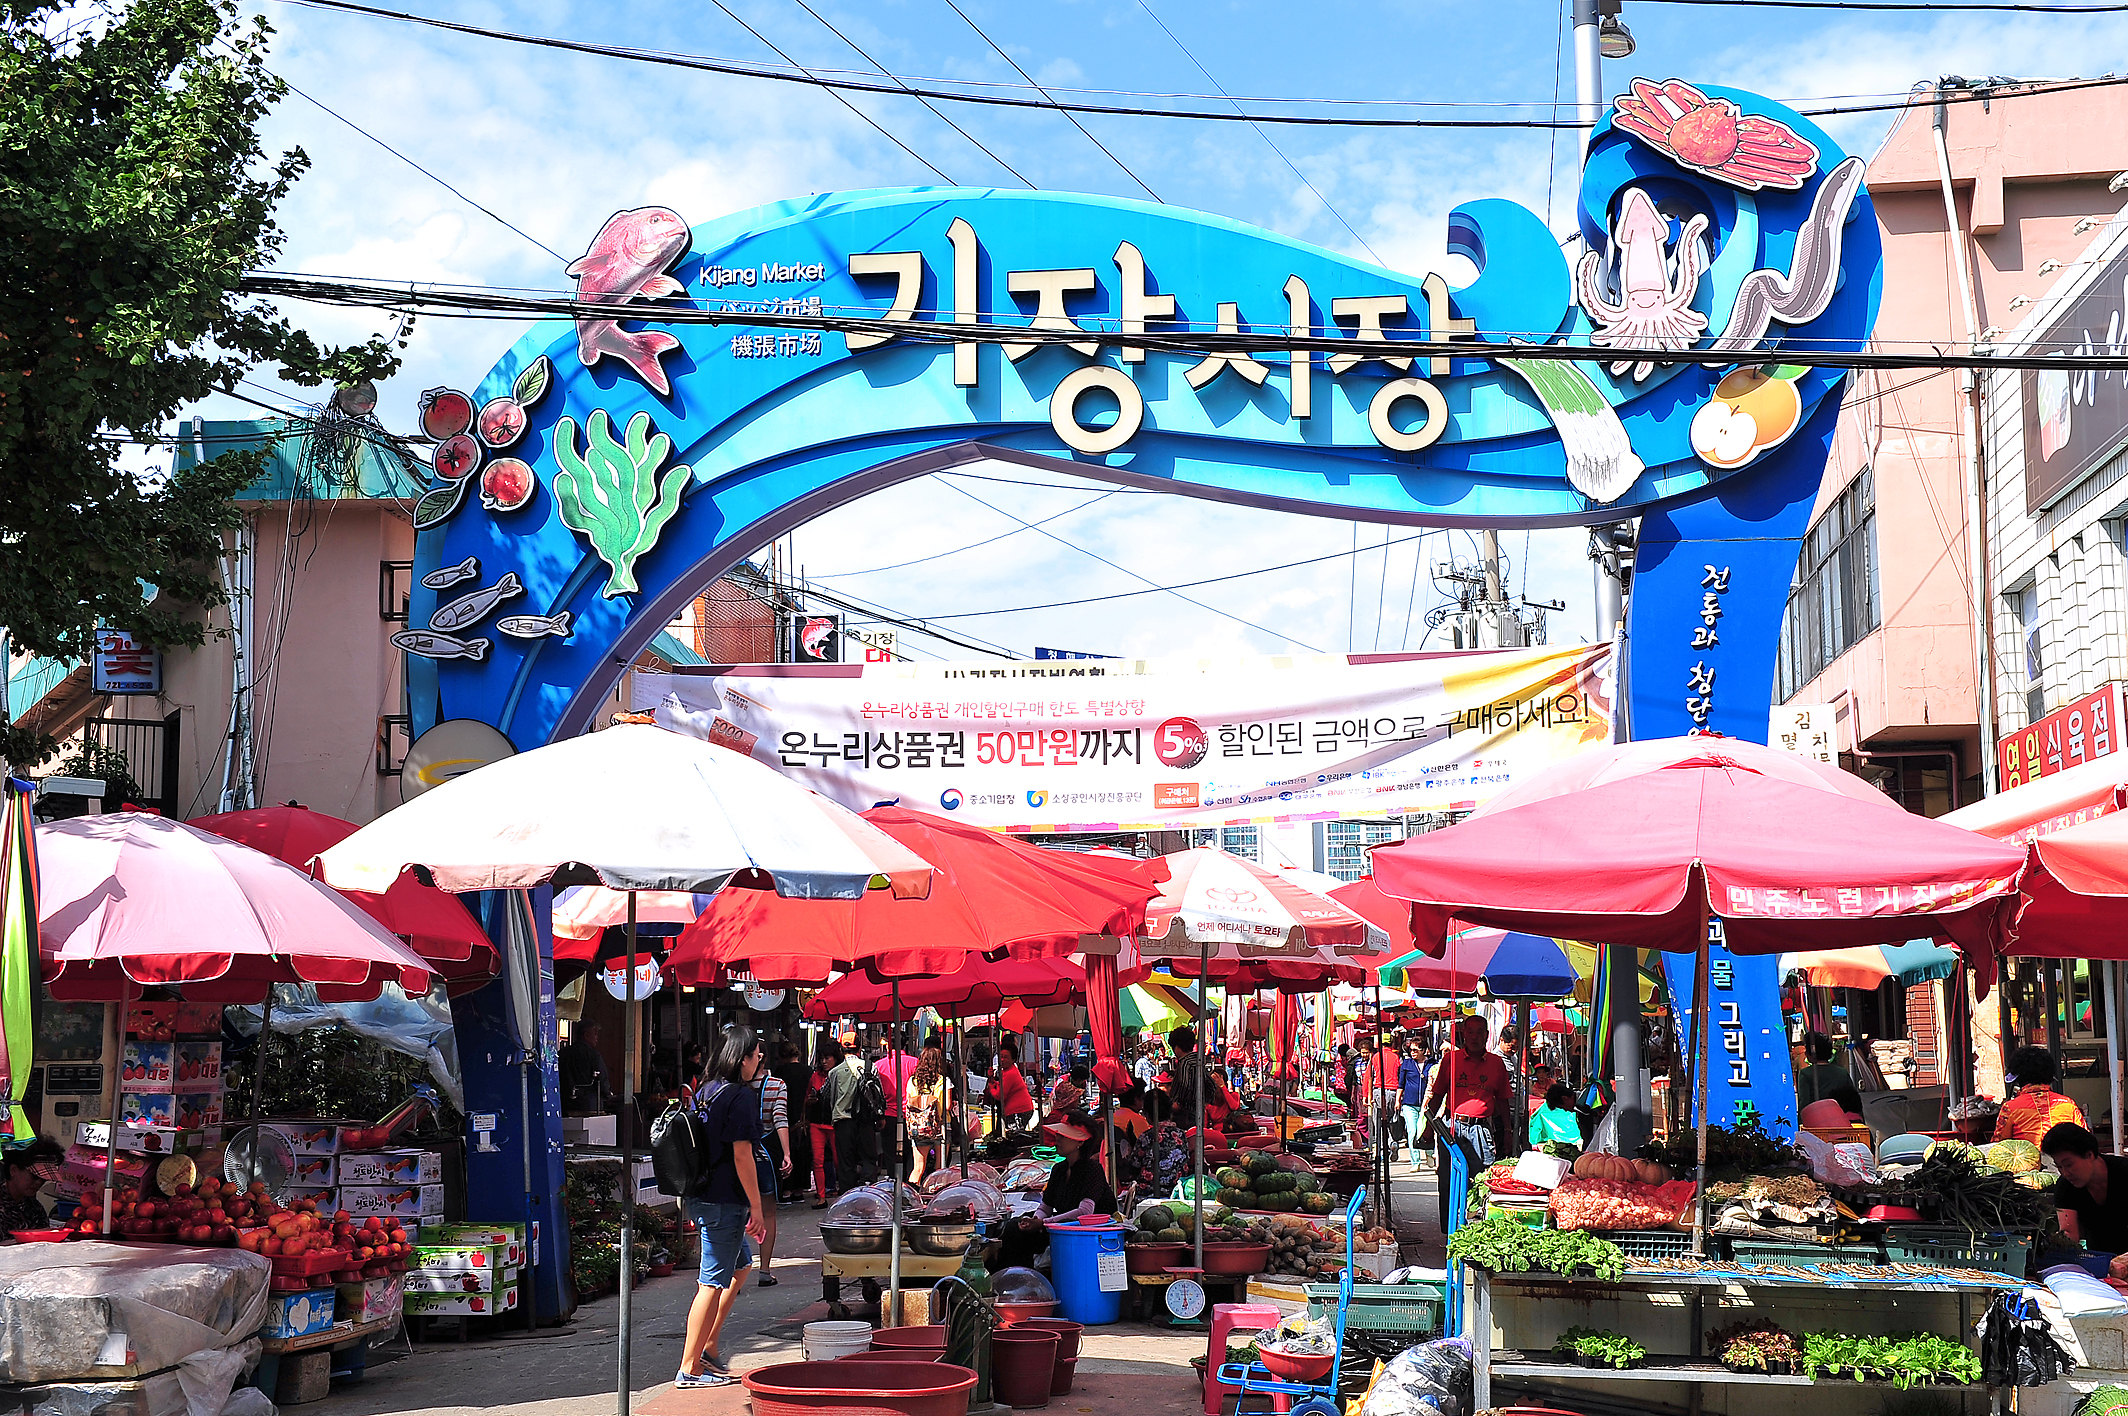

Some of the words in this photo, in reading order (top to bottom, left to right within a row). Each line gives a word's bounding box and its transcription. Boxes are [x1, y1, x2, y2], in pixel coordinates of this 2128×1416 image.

[700, 265, 757, 288] Kijang
[761, 262, 826, 283] Market
[847, 216, 1475, 454] 기장시장
[1690, 564, 1732, 648] 전통과
[863, 632, 895, 645] 기장
[860, 701, 949, 719] 온누리상품권
[954, 701, 1045, 718] 개인할인구매
[1050, 700, 1080, 717] 한도
[1085, 699, 1146, 717] 특별상향
[1795, 711, 1811, 730] 김
[712, 718, 744, 741] 5000
[776, 729, 966, 769] 온누리상품권
[976, 727, 1141, 767] 50만원까지
[1161, 724, 1203, 759] 5%
[1217, 721, 1303, 758] 할인된
[1313, 716, 1428, 754] 금액으로
[1436, 692, 1590, 739] 구매하세요!
[2006, 695, 2111, 791] 영일식육점
[1197, 921, 1216, 932] 언제
[1217, 921, 1252, 934] 어디서나
[1253, 925, 1282, 938] 토요타
[1710, 959, 1733, 991] 물
[1717, 1001, 1751, 1085] 그리고
